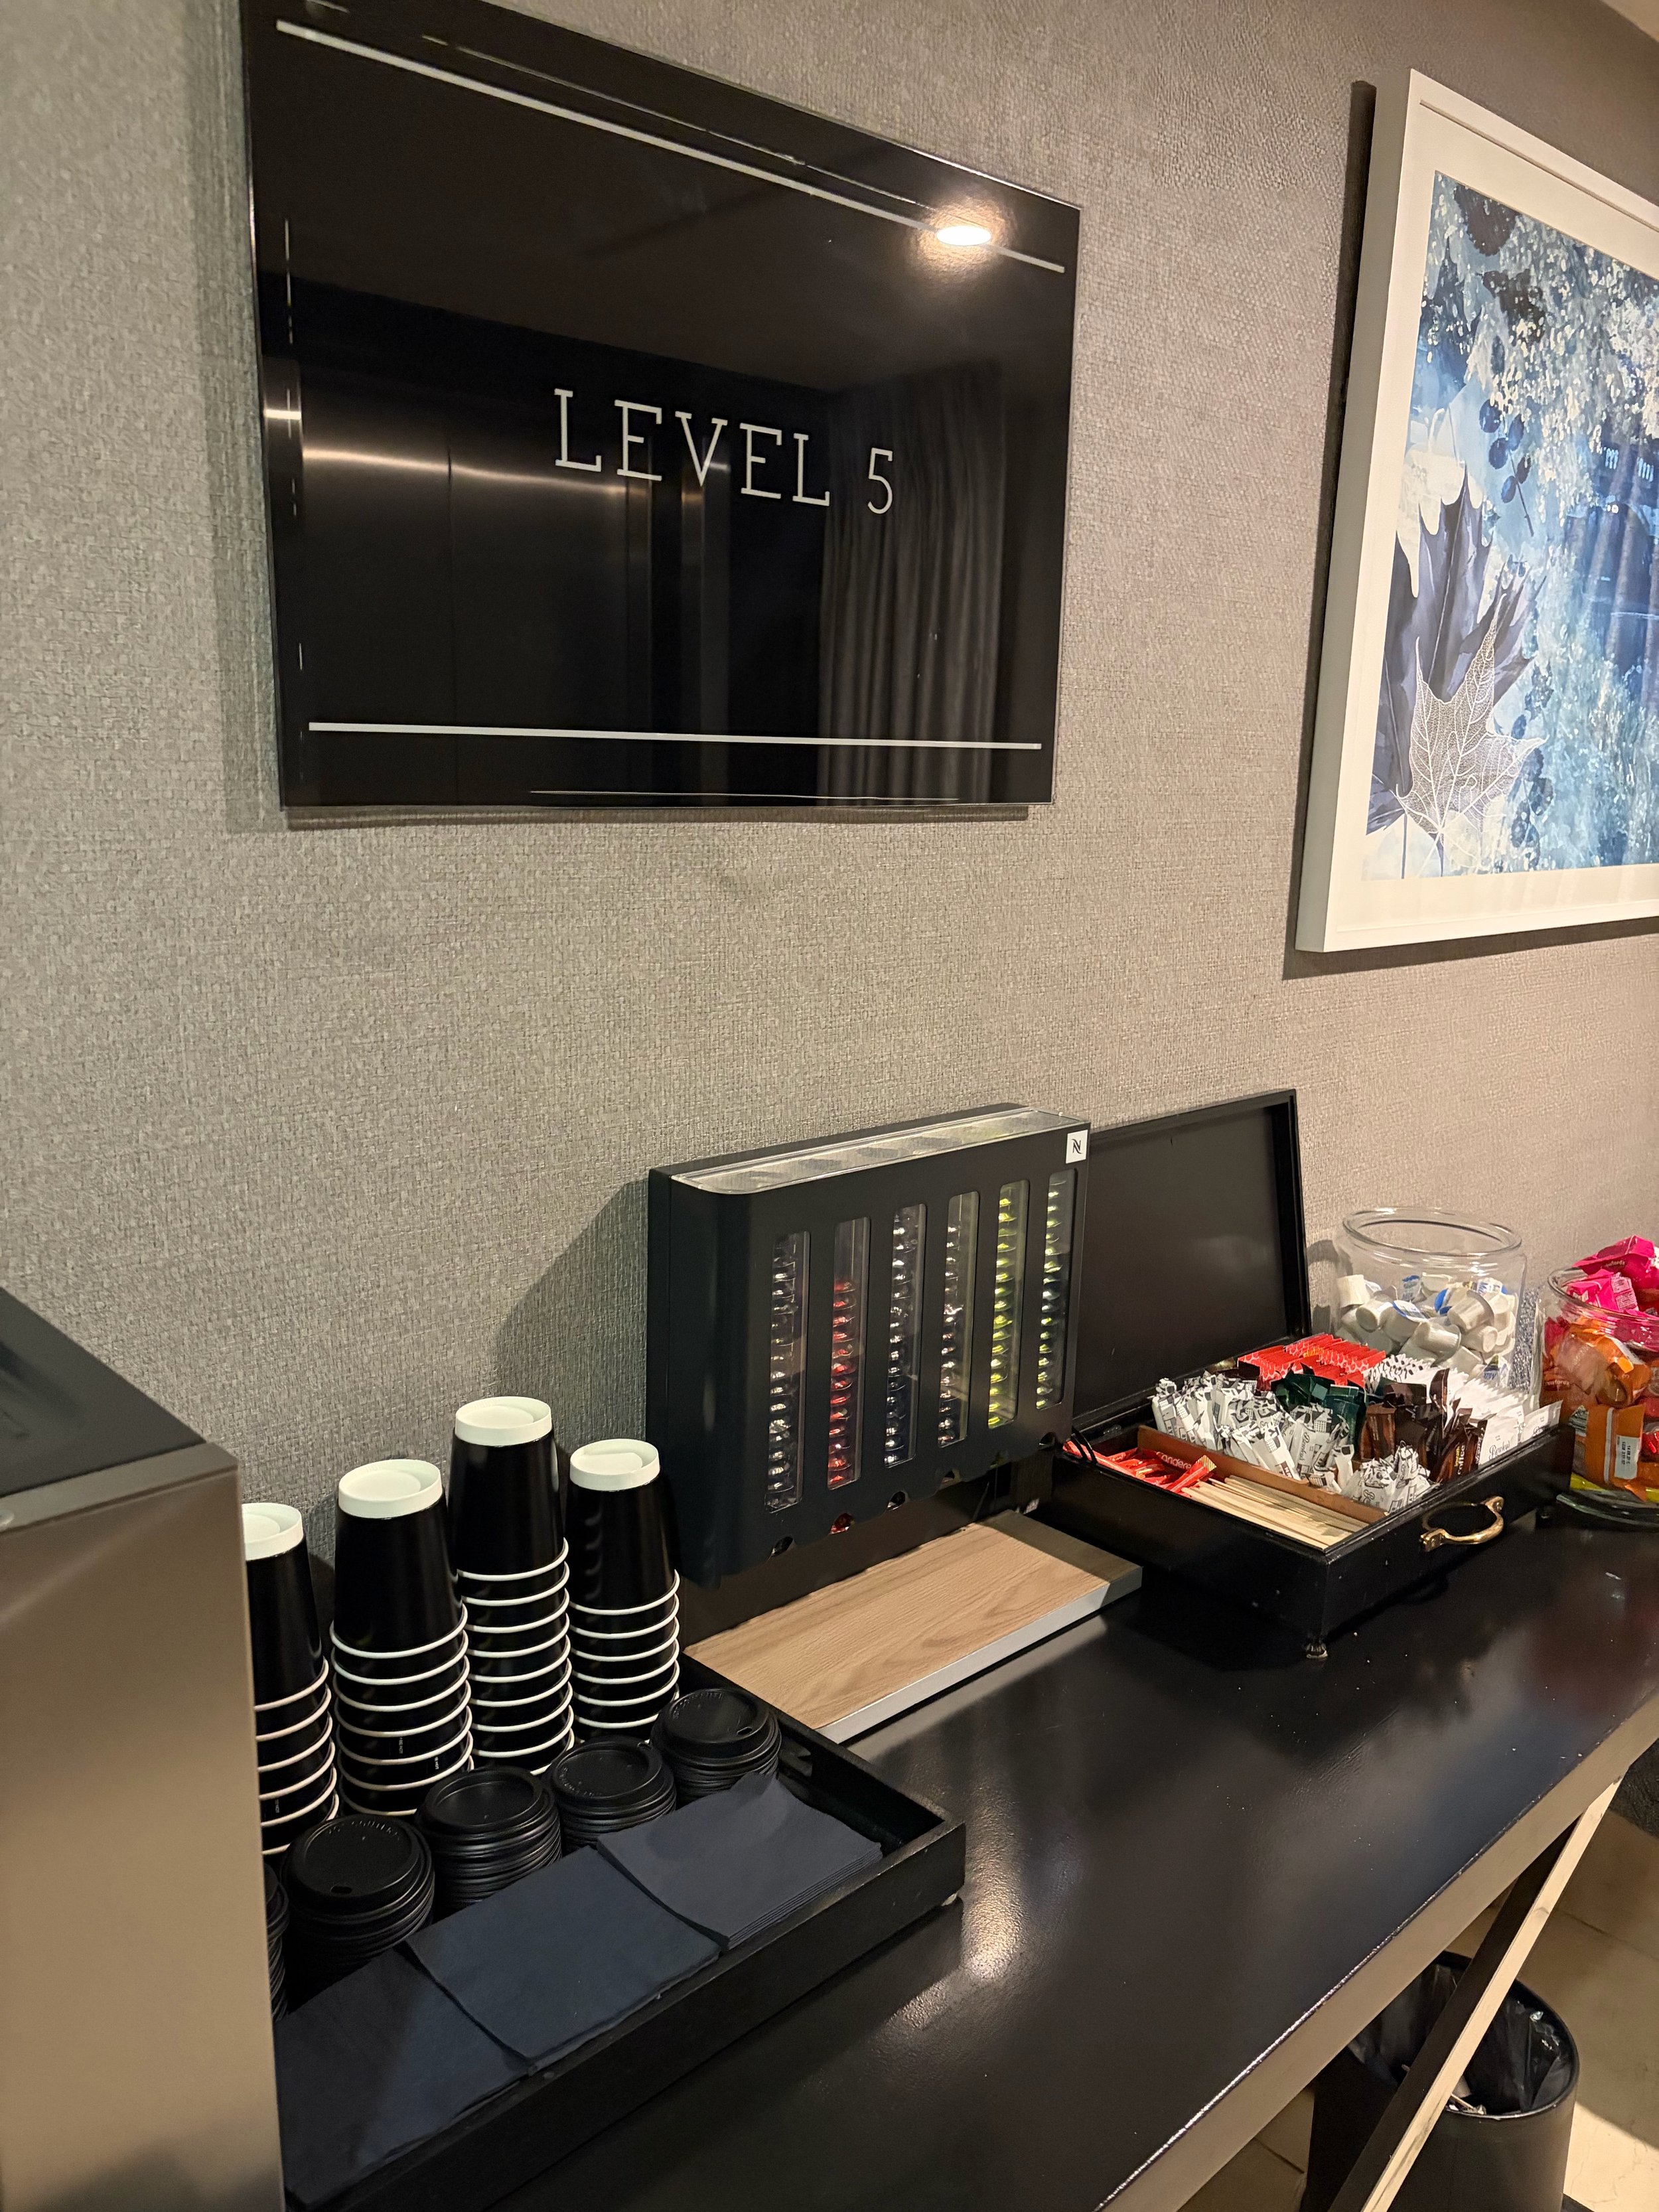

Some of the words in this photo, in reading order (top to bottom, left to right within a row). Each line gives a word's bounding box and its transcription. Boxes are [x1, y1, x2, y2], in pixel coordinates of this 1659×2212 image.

[554, 388, 830, 506] LEVEL
[867, 447, 893, 514] 5
[1156, 1451, 1192, 1470] andere
